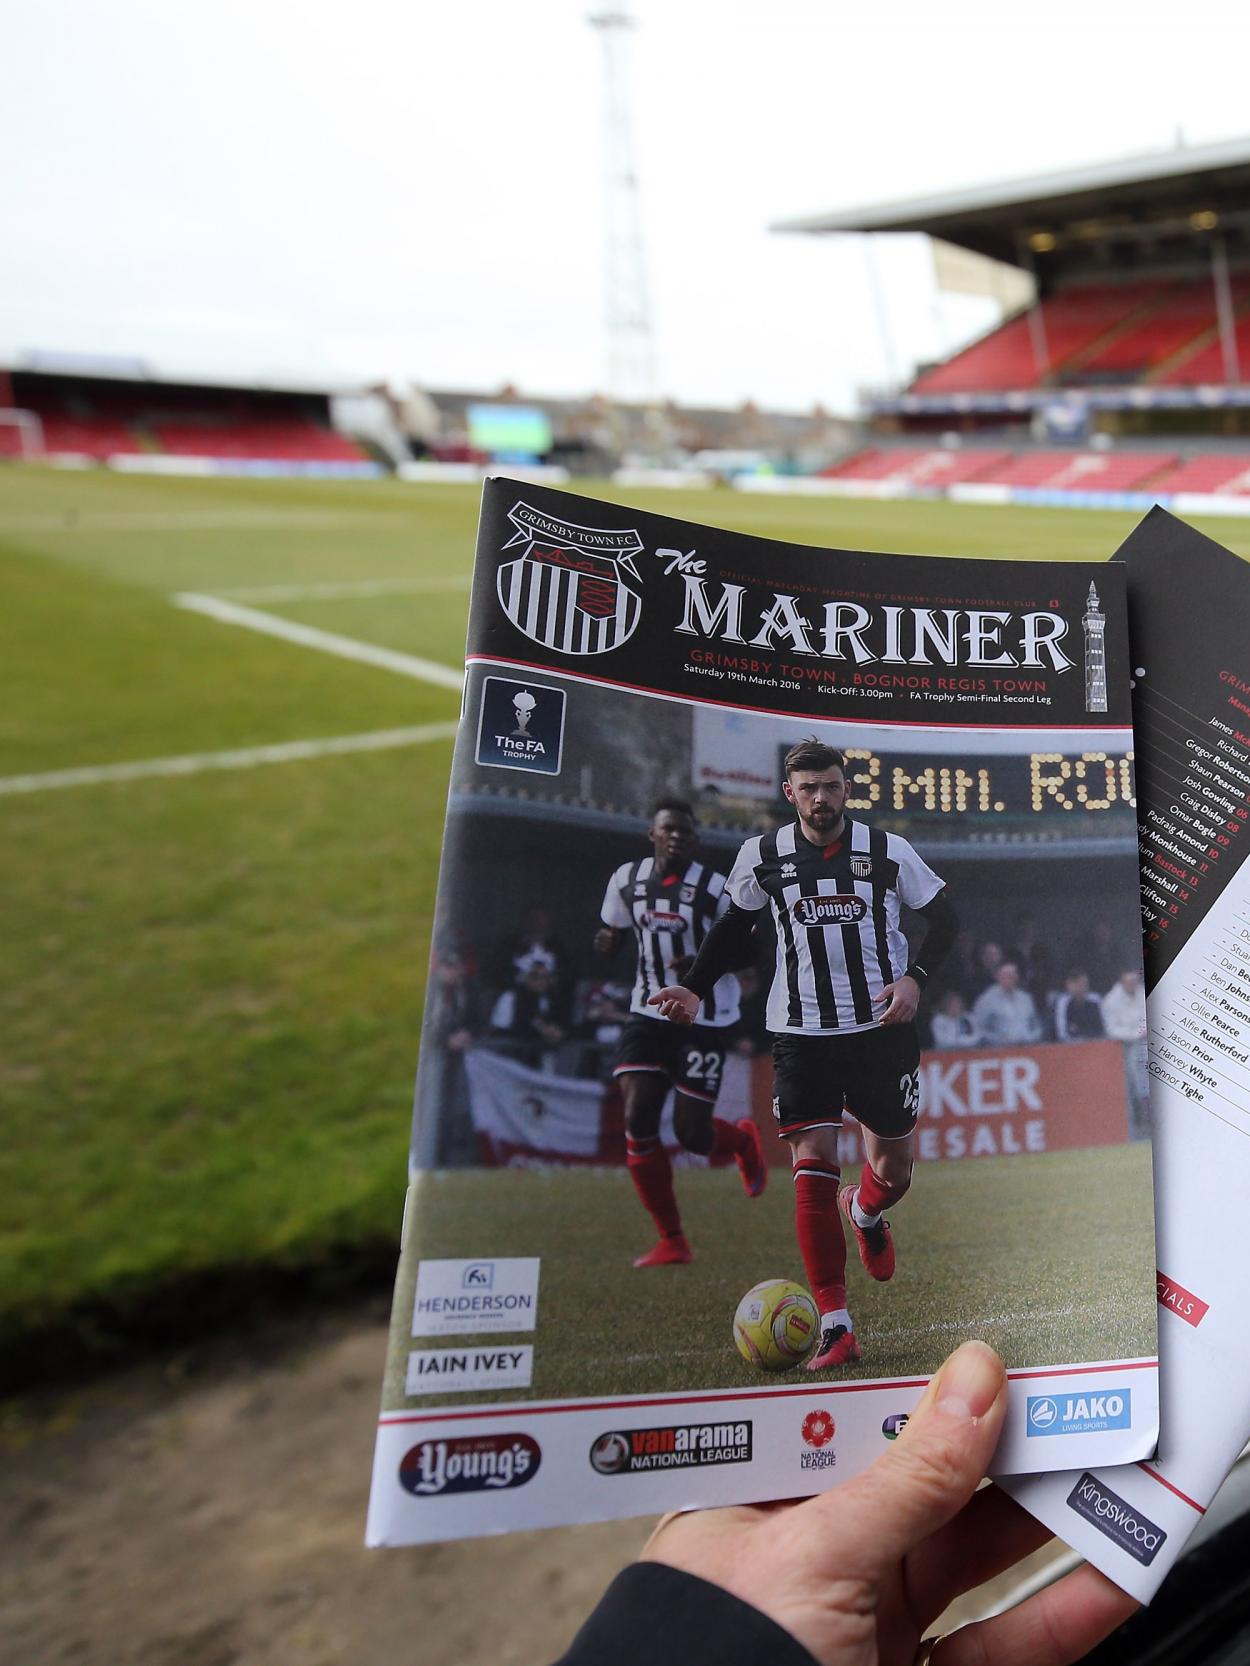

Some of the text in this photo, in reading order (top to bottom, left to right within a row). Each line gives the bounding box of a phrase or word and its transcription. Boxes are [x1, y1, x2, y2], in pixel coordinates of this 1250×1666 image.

[519, 508, 637, 546] GRIMSBY TOWN F.C.
[655, 548, 707, 575] The
[720, 571, 762, 585] OFFICIAL
[766, 580, 818, 593] MATCHDAY
[890, 594, 929, 603] GRIMSBY
[964, 599, 1011, 607] FOOTBALL
[674, 574, 1077, 674] MARINER
[684, 663, 1051, 705] Saturday 19th March 2016 Kick-Off: 3.00pm FA Trophy Semi-Final Second Leg
[690, 649, 1046, 692] GRIMSBY TOWN BOGNOR REGIS TOWN
[1209, 716, 1234, 735] James
[503, 750, 536, 761] TROPHY
[1186, 739, 1213, 759] Gregor
[1217, 739, 1248, 761] Richard
[844, 749, 880, 810] 3
[1189, 759, 1213, 778] Shaun
[1213, 774, 1246, 798] Pearson
[1180, 792, 1239, 833] Craig Disley 08
[1182, 775, 1248, 819] Josh Gowling 06
[1147, 810, 1219, 859] Padraig Amond 10
[1169, 805, 1230, 846] Omar Bogle 09
[1150, 831, 1197, 866] Monkhouse
[1199, 863, 1209, 873] 11
[1141, 866, 1190, 900] Marshall 14
[1154, 853, 1187, 879] Bastock
[1189, 876, 1199, 886] 13
[801, 899, 861, 924] Young's
[1140, 884, 1180, 914] Clifton 15
[1159, 918, 1169, 928] 16
[1210, 972, 1227, 987] Ben
[1220, 957, 1237, 973] Dan
[1200, 987, 1220, 1004] Alex
[1190, 1001, 1240, 1037] Ollie Pearce
[1168, 1031, 1214, 1064] Jason Prior
[1179, 1016, 1250, 1063] Alfie Rutherford
[686, 1051, 720, 1079] 22
[1148, 1061, 1205, 1102] Connor Tighe
[1158, 1046, 1218, 1089] Harvey Whyte
[919, 1119, 1046, 1161] ESALE
[418, 1294, 531, 1313] HENDERSON
[418, 1352, 523, 1374] IAIN IVEY
[1062, 1395, 1123, 1421] JAKO
[631, 1423, 748, 1454] vanarama
[1083, 1421, 1108, 1430] SPORTS
[414, 1441, 531, 1493] Young's
[631, 1447, 748, 1469] NATIONAL LEAGUE
[801, 1450, 836, 1469] NATIONAL LEAGUE
